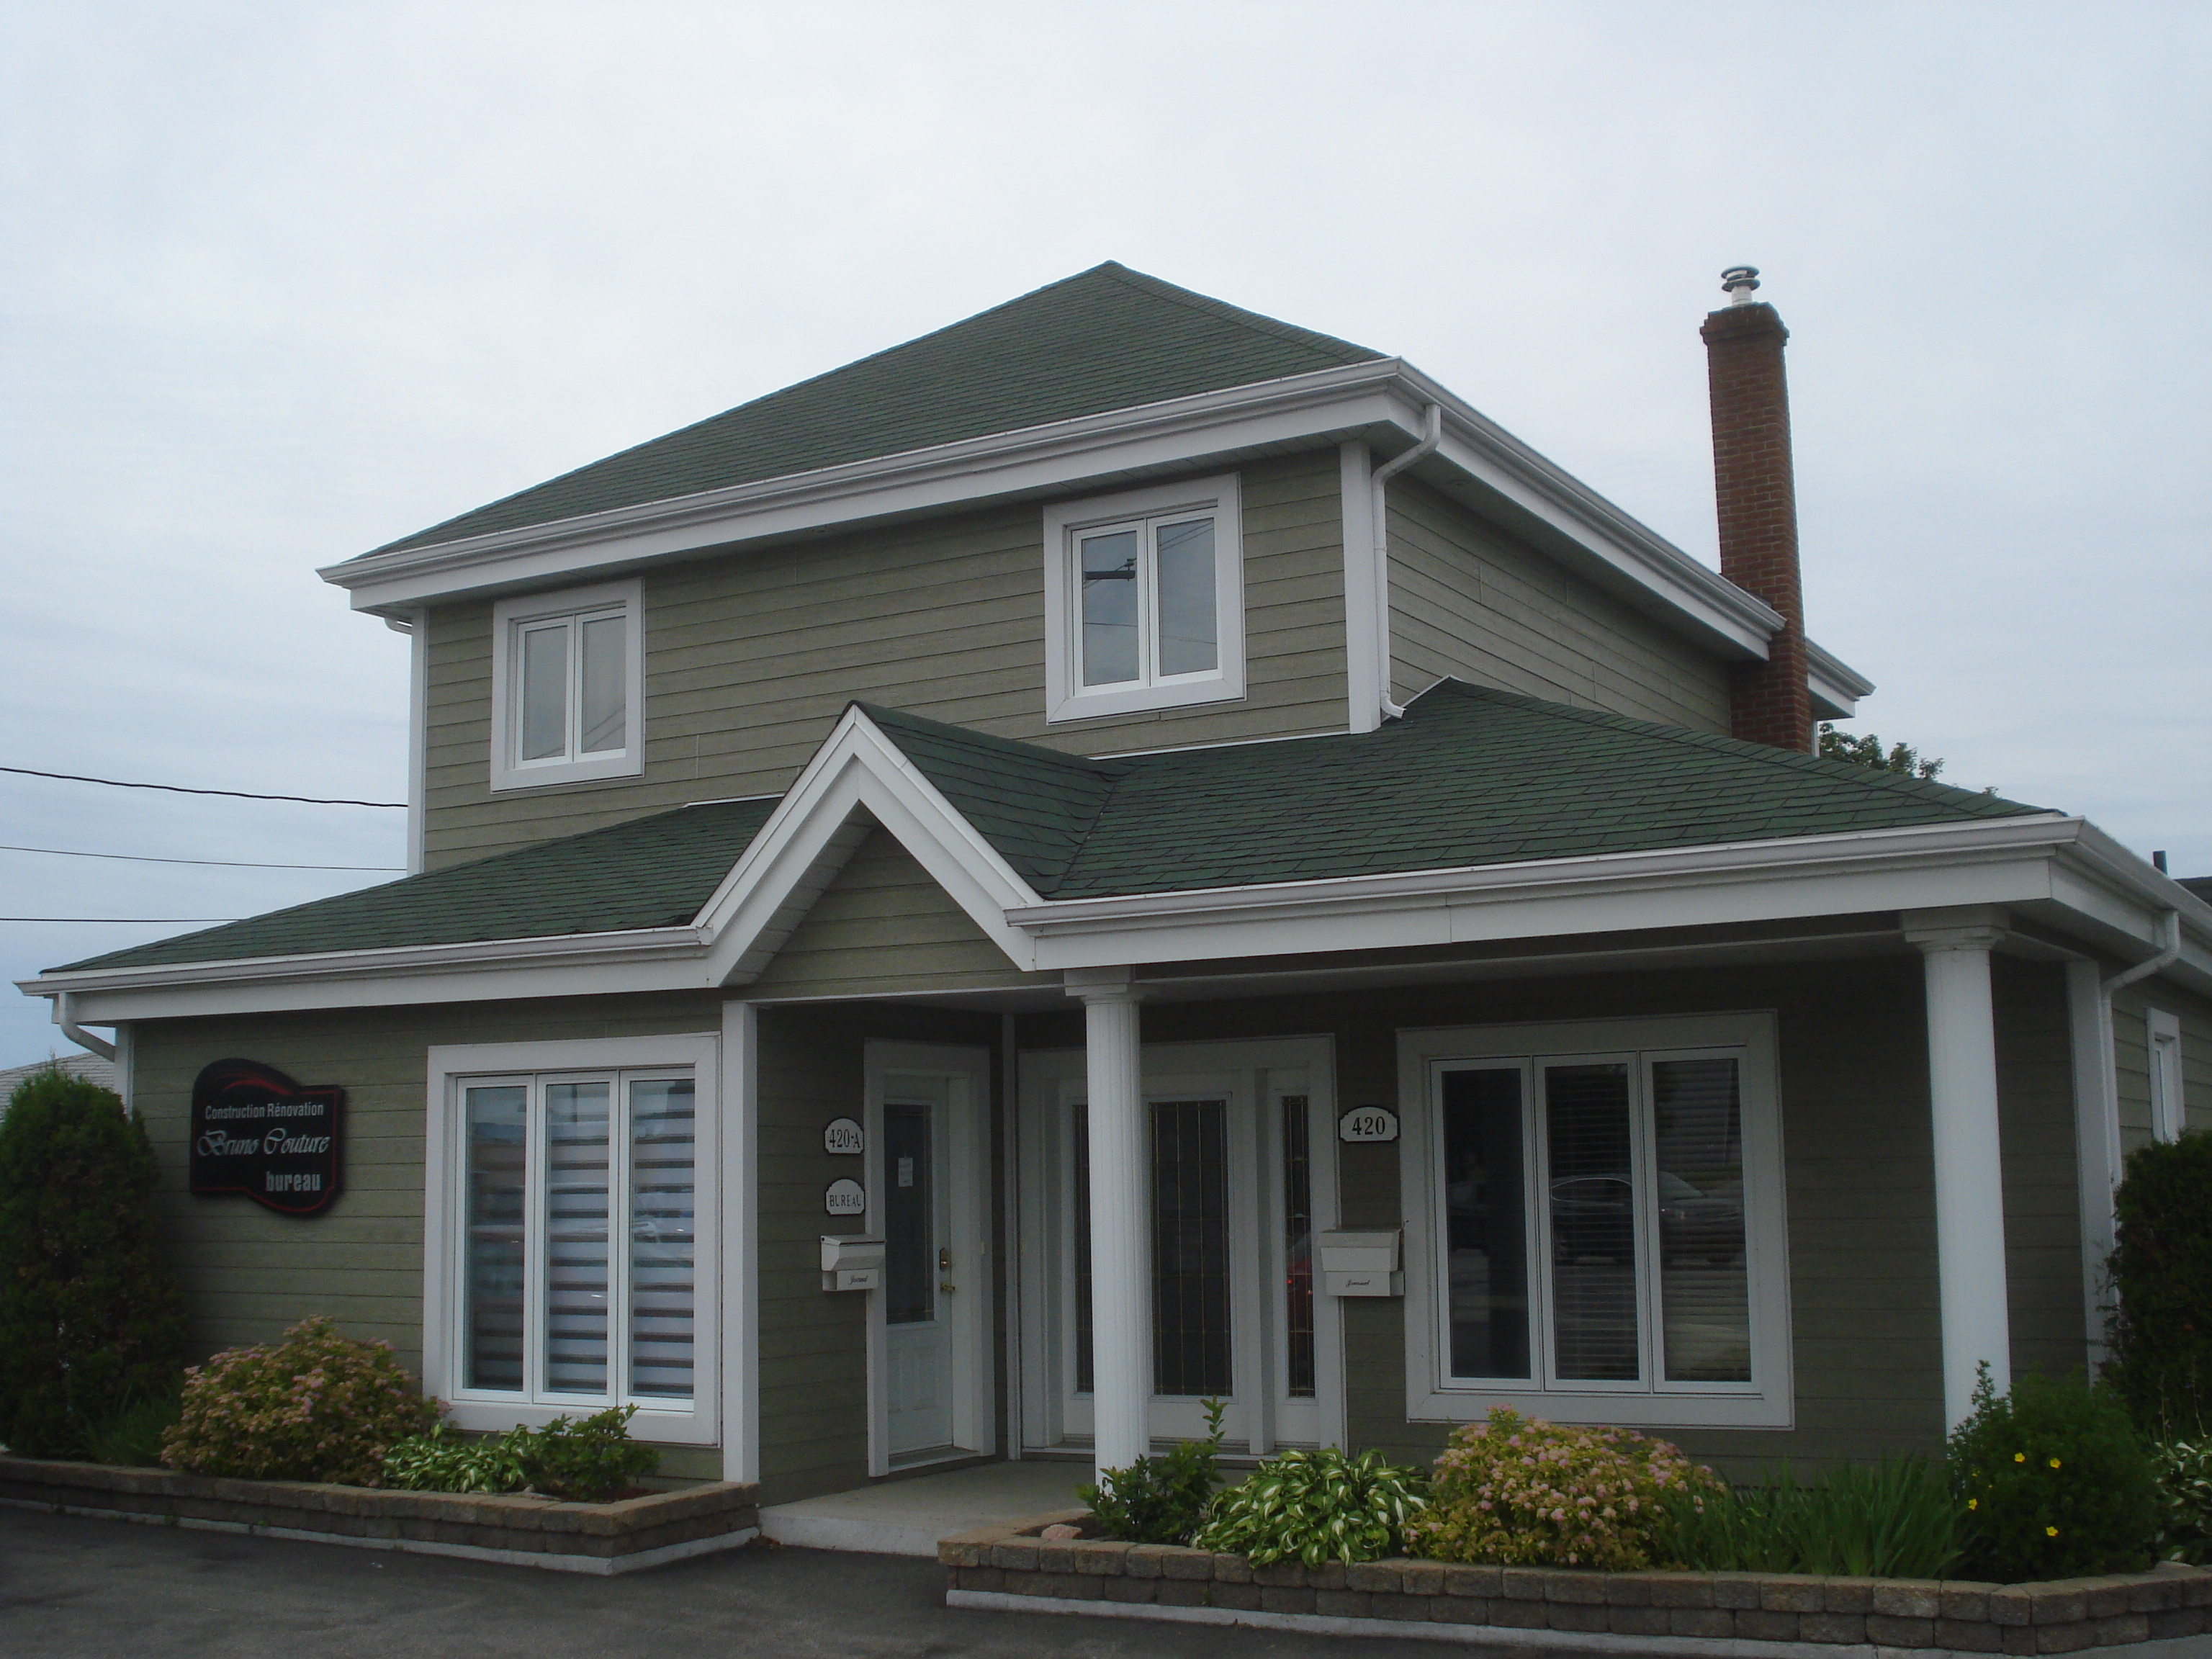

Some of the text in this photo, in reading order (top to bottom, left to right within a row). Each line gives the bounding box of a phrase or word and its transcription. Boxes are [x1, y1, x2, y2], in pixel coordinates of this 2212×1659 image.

[205, 1102, 324, 1120] Construction Rénovation
[1352, 1116, 1386, 1135] 420
[197, 1128, 331, 1156] Bruno Couture
[830, 1128, 860, 1148] 420-A
[266, 1171, 321, 1192] bureau
[830, 1194, 861, 1207] BUREAU
